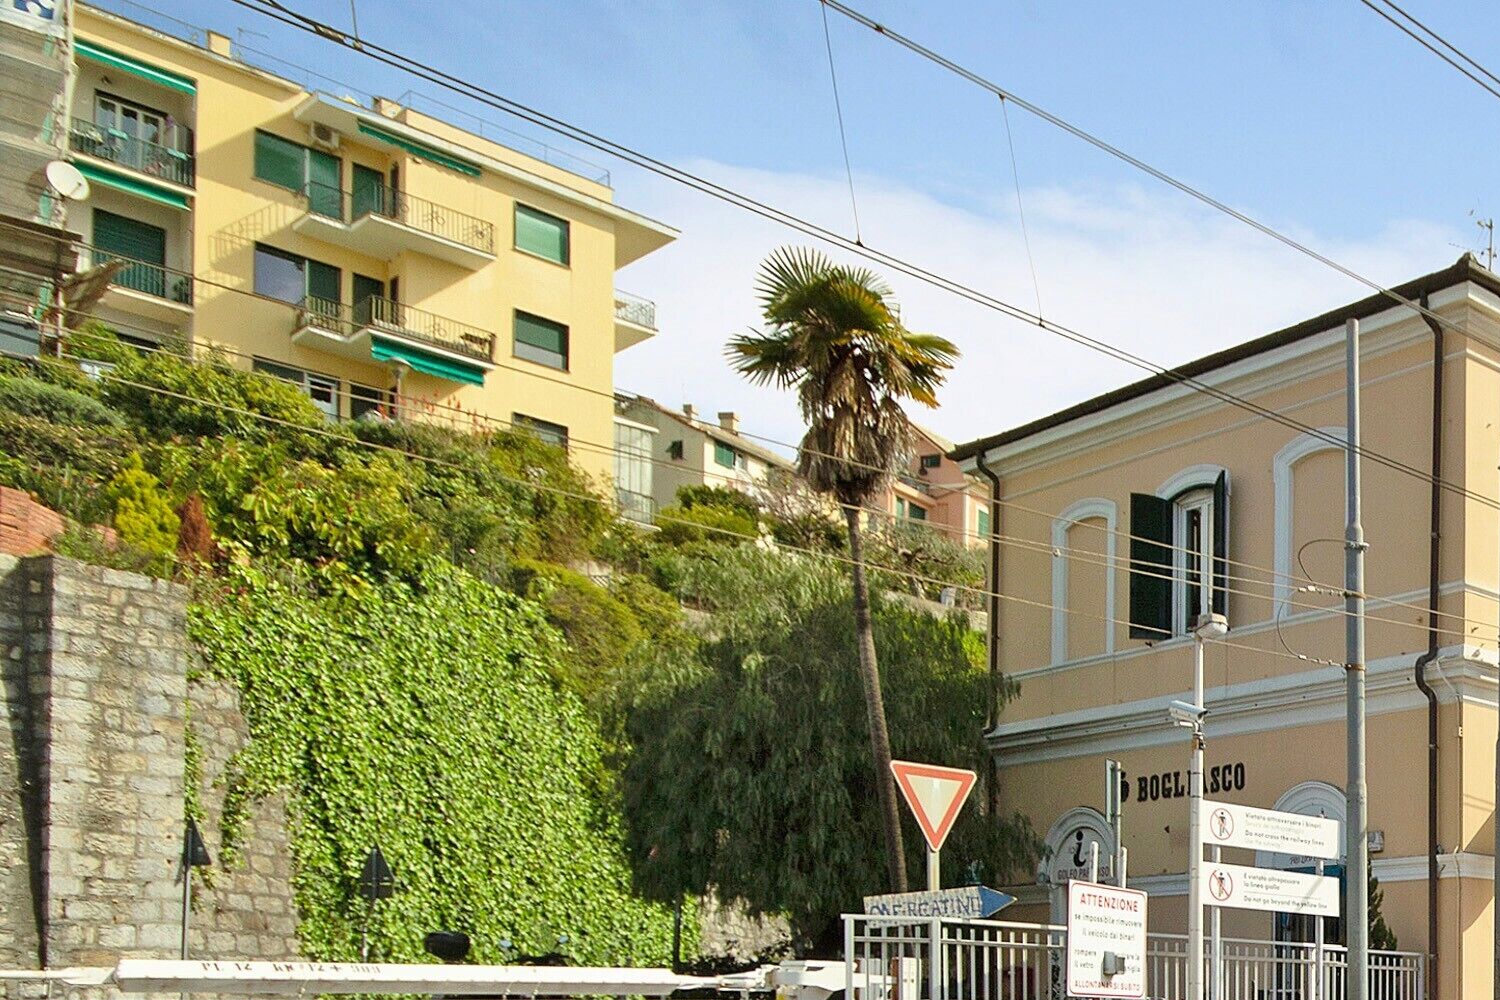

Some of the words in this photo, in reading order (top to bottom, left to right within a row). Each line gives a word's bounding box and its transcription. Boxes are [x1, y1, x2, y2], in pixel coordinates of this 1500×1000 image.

[1280, 833, 1289, 841] the
[1290, 836, 1311, 846] railway
[1080, 893, 1138, 912] ATTENZIONE
